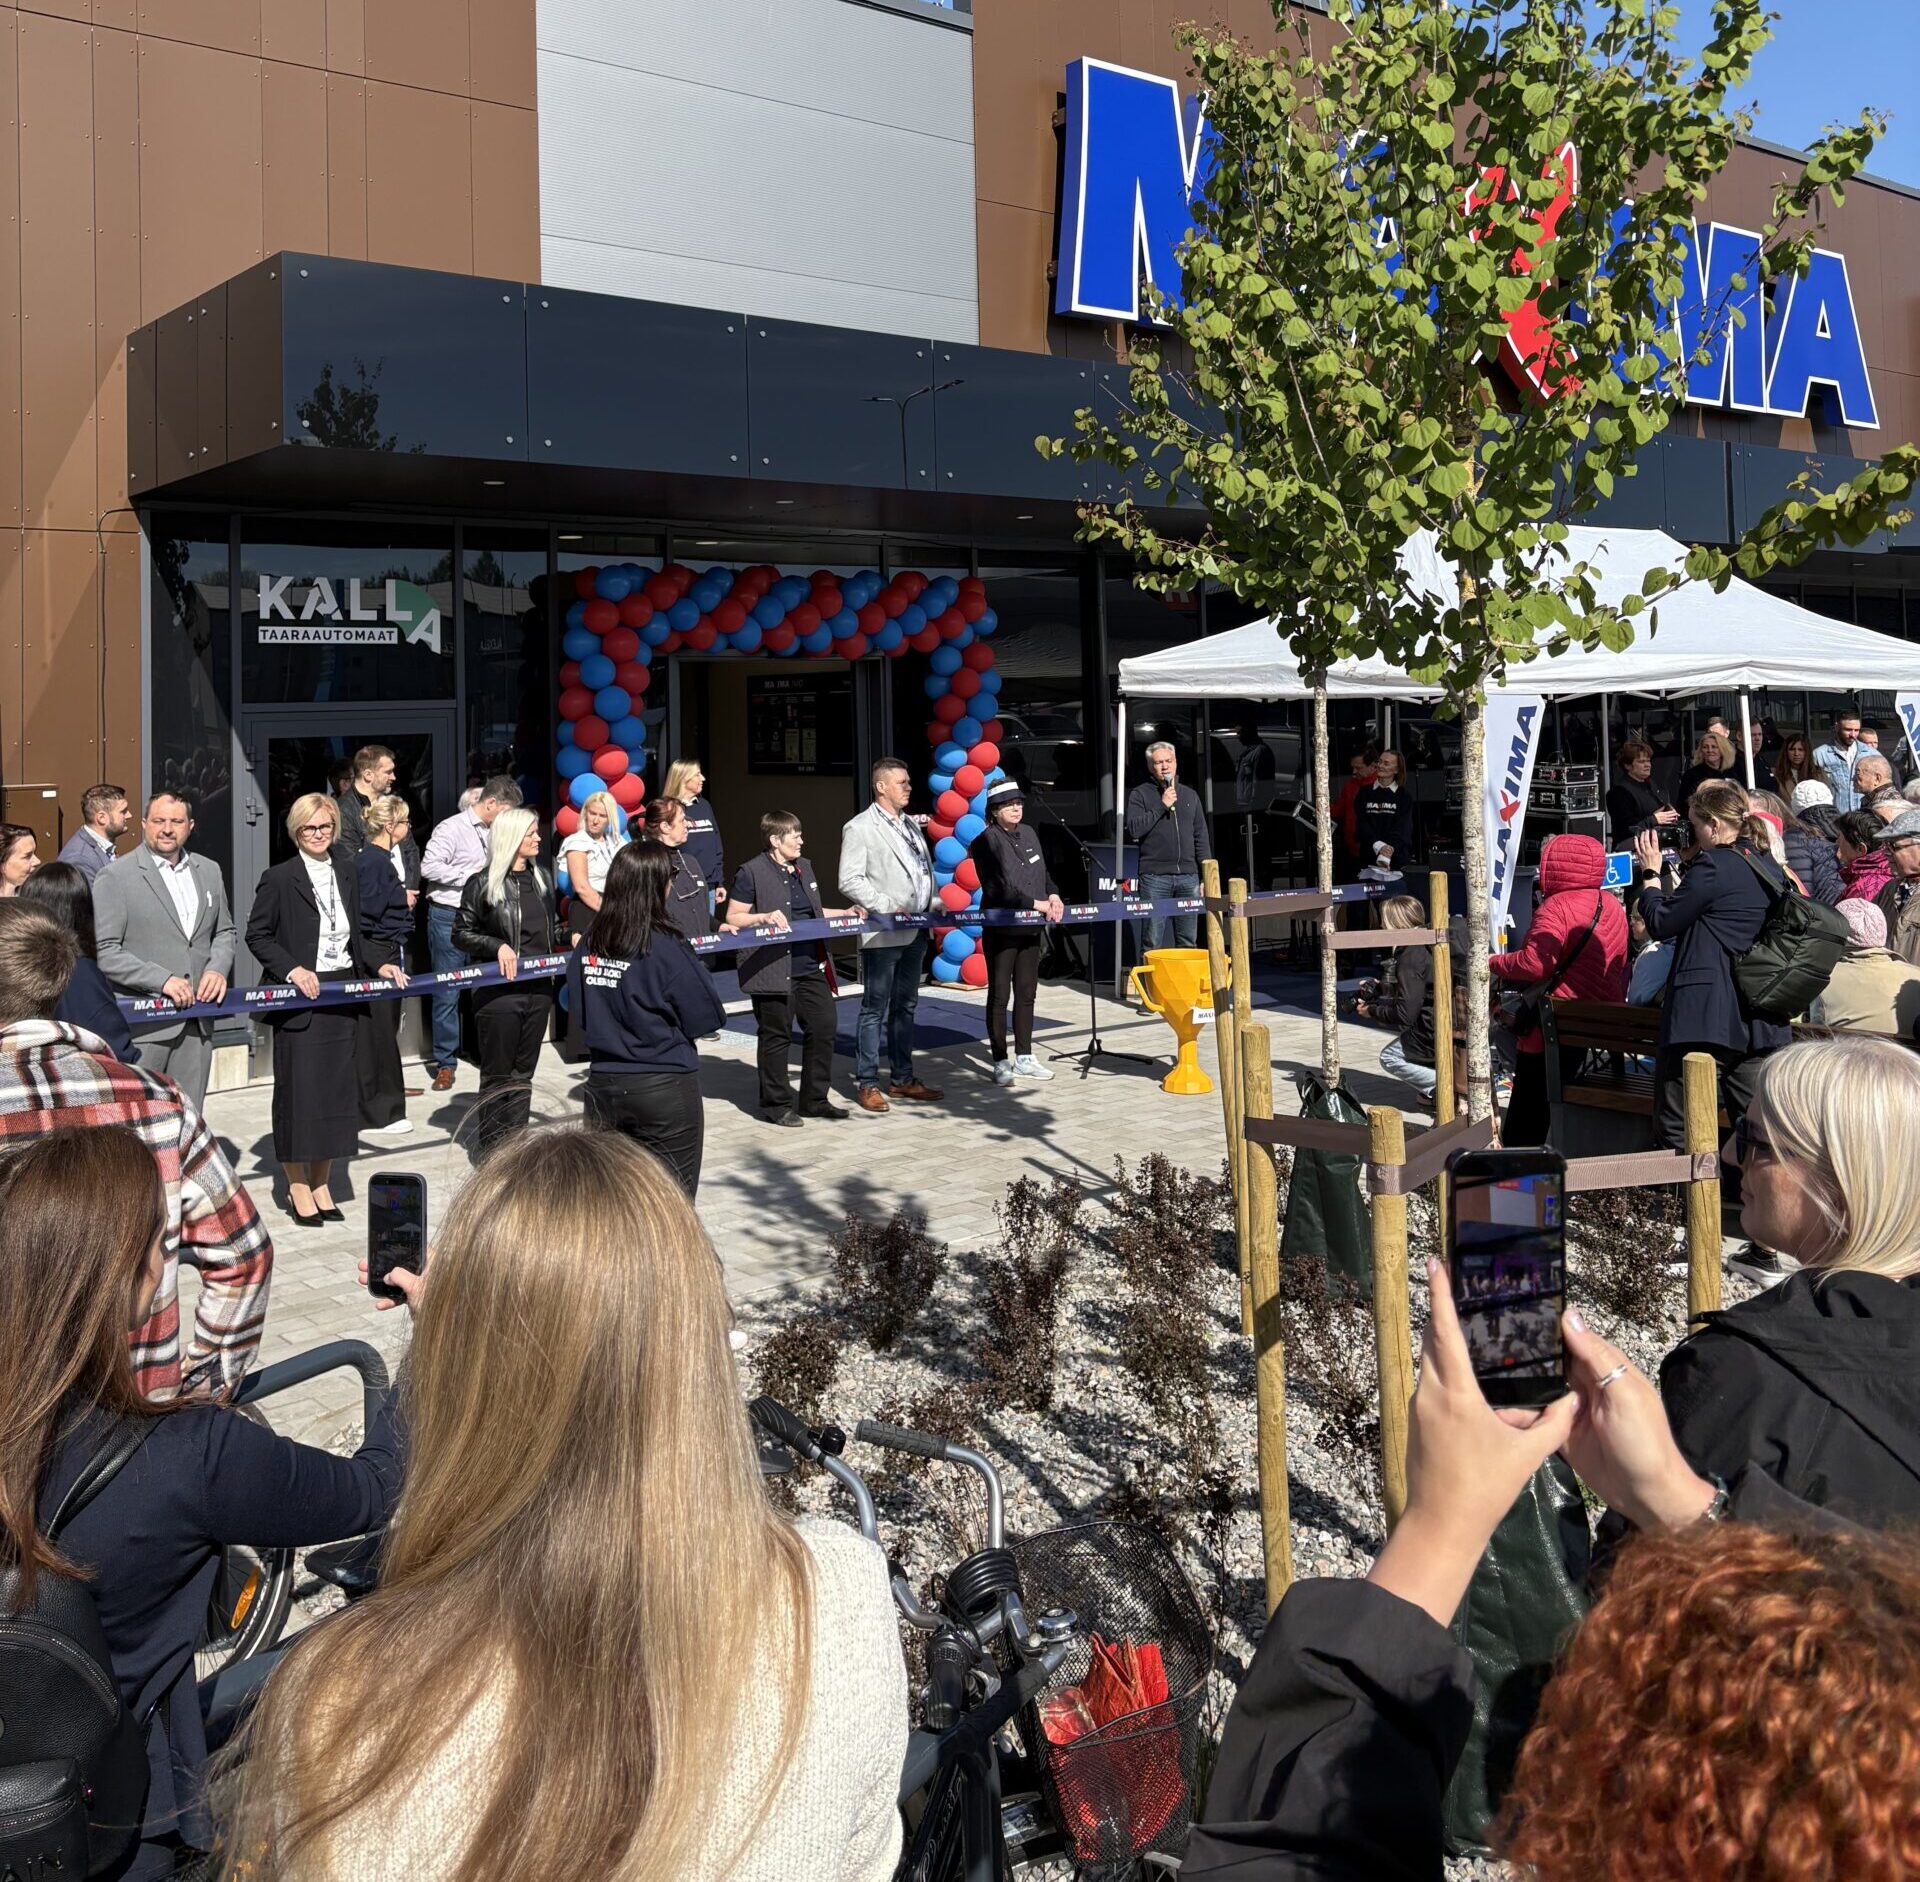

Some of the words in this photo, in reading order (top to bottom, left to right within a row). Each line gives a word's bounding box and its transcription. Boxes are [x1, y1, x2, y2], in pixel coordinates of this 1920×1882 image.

[259, 575, 441, 655] KALLA
[260, 629, 396, 641] TAARAAUTOMAAT
[829, 917, 865, 928] MAXIMA
[687, 934, 721, 945] AXIMA
[523, 955, 566, 970] MAXIMA
[436, 967, 483, 982] MAXIMA
[344, 980, 393, 993] MAXIMA
[245, 988, 297, 1001] MAXIMA
